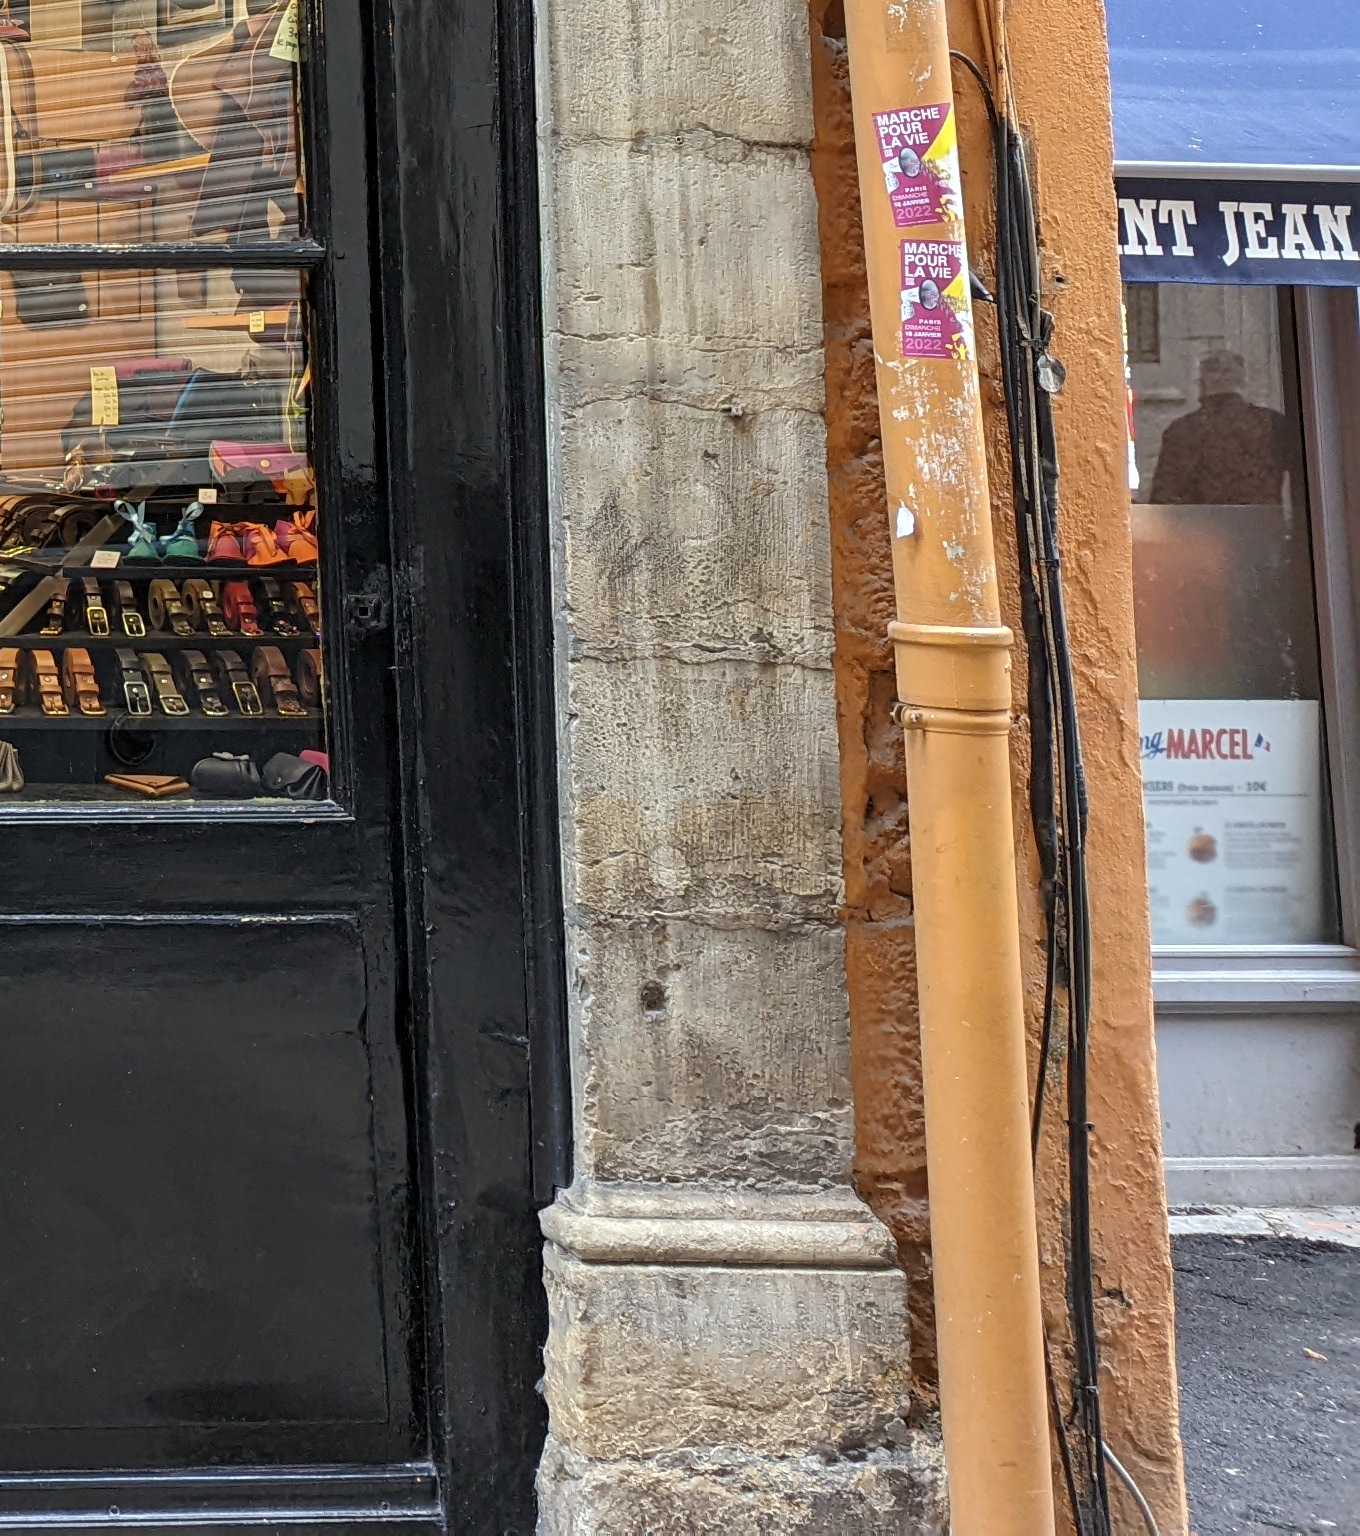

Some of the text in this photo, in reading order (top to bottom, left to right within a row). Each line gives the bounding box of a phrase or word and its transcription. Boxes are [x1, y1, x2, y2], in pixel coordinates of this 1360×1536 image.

[876, 107, 940, 127] MARCHE
[880, 122, 923, 138] POUR
[881, 132, 930, 150] LA VIE
[895, 205, 933, 220] 2022
[1117, 198, 1360, 267] NT JEAN
[904, 242, 962, 255] MARCHE
[904, 254, 948, 267] POUR
[904, 266, 952, 279] LA VIE
[905, 338, 942, 351] 2022
[1140, 728, 1254, 760] ng MARCEL
